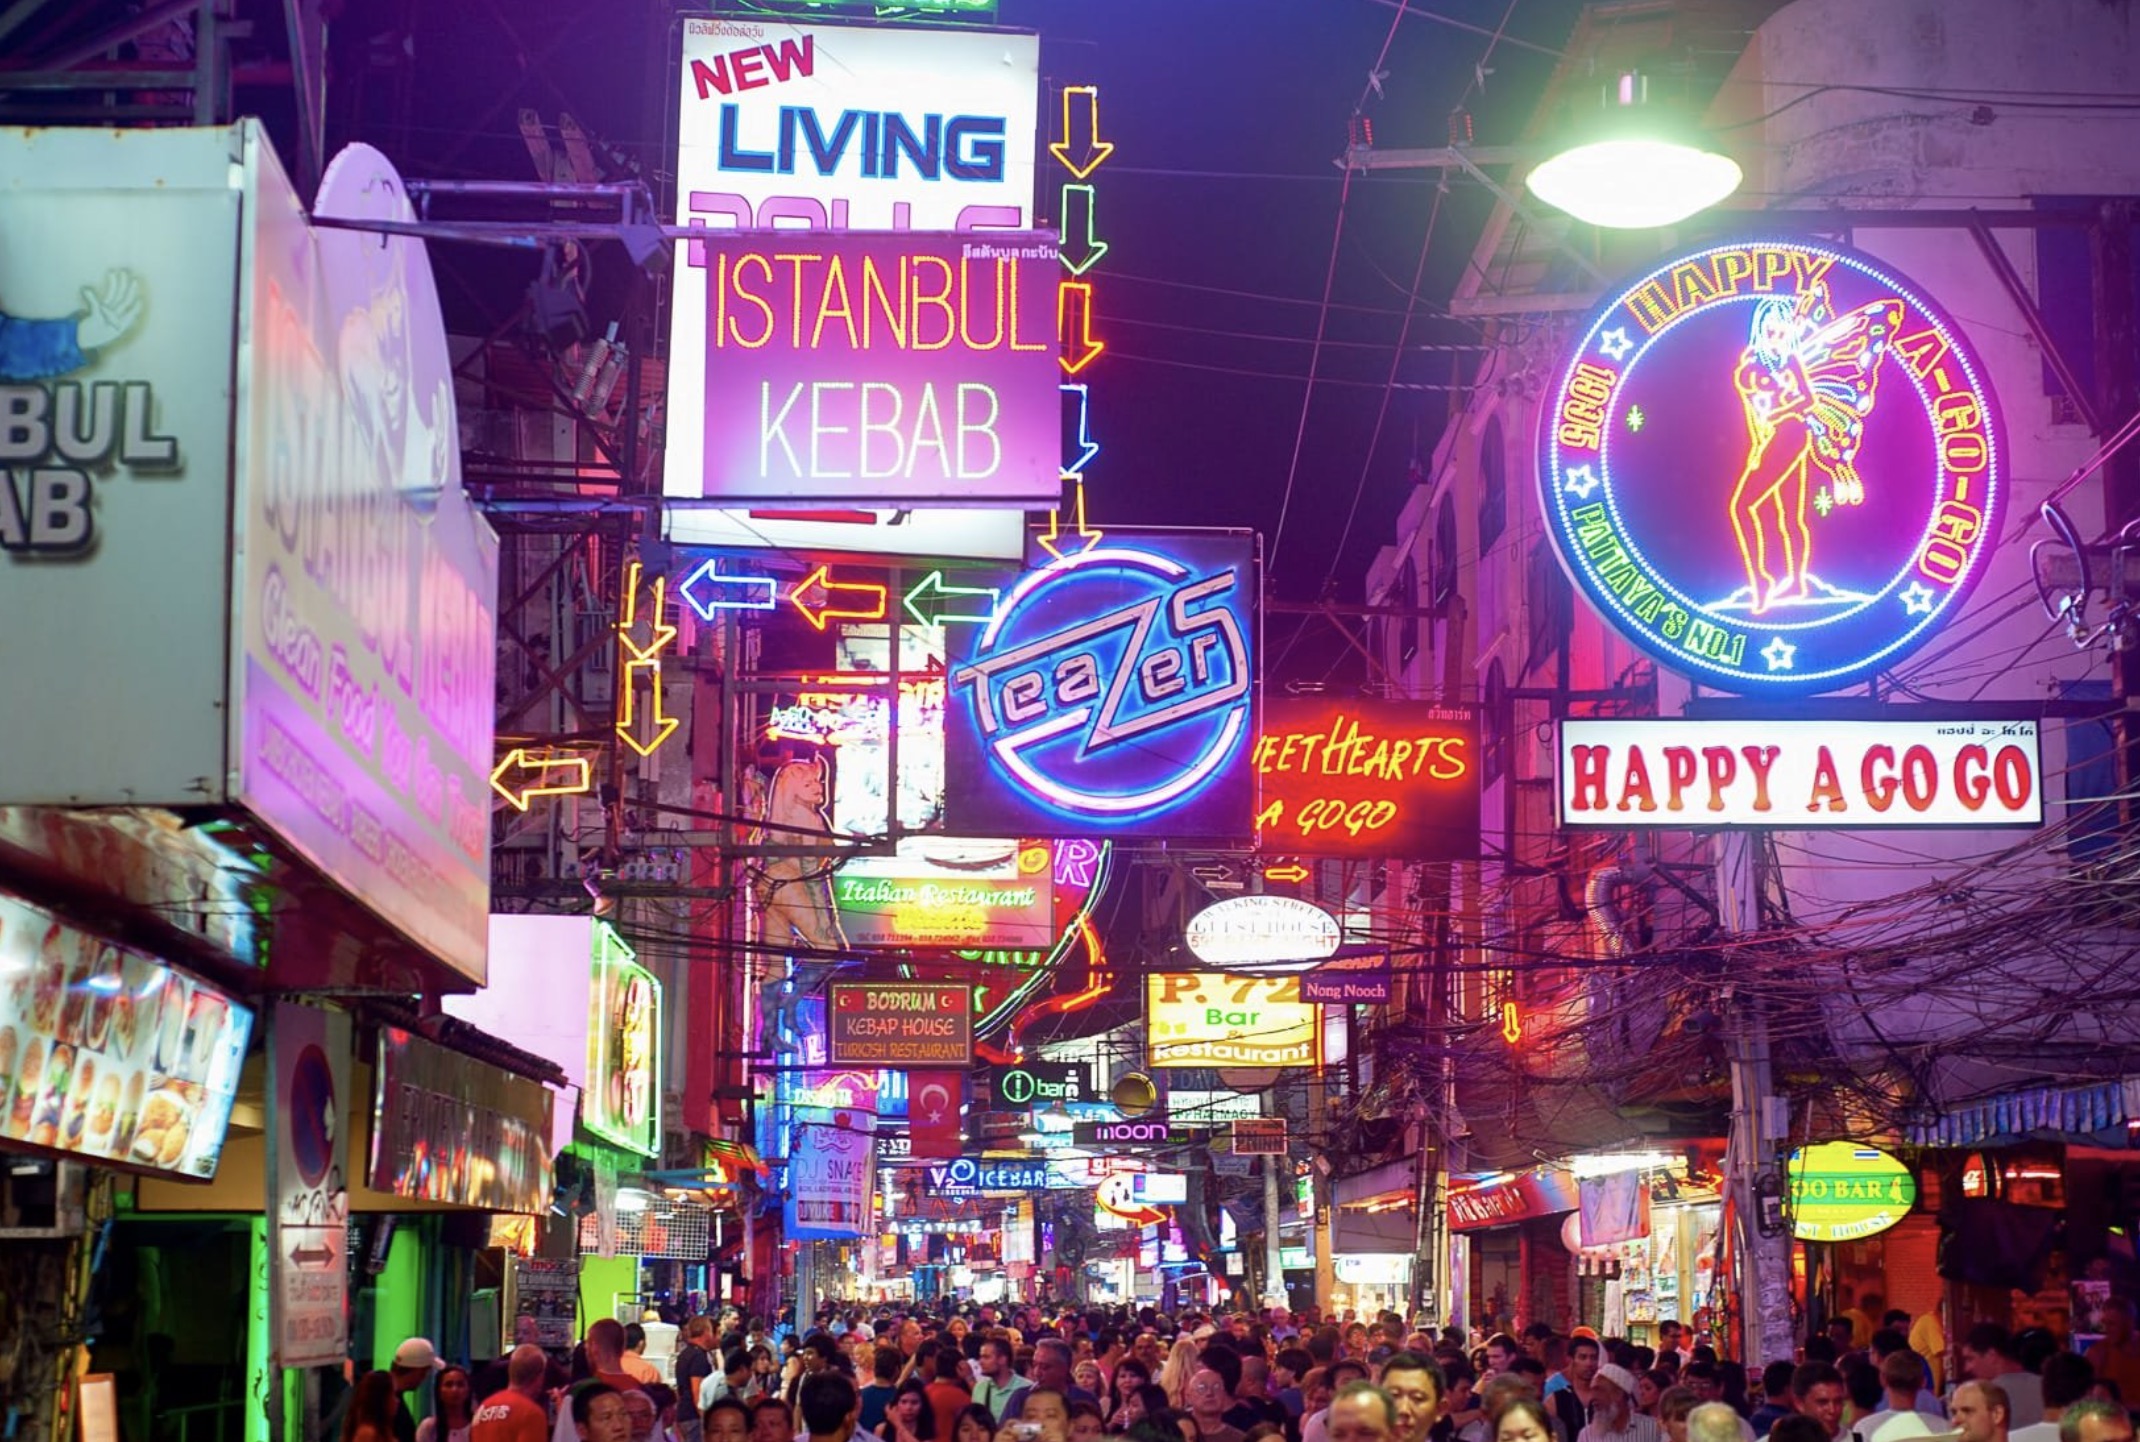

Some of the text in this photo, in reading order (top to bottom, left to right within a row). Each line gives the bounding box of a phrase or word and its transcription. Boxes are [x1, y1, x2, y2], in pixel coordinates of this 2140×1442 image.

[690, 34, 814, 100] NEW
[718, 103, 1006, 182] LIVING
[716, 252, 1048, 351] ISTANBUL
[1626, 248, 1831, 334] HAPPY
[760, 381, 1001, 479] KEBAB
[1570, 743, 1781, 812] HAPPY
[1806, 744, 1848, 813] A
[1254, 798, 1398, 837] A GOGO
[841, 880, 1037, 908] Italian Restaurant
[866, 991, 936, 1012] BODRUM
[1306, 983, 1386, 999] Nong Nooch
[846, 1017, 956, 1037] KEBAP HOUSE
[1206, 1008, 1260, 1026] Bar
[837, 1042, 966, 1059] TURKISH RESTAURANT
[1834, 1180, 1883, 1199] BAR
